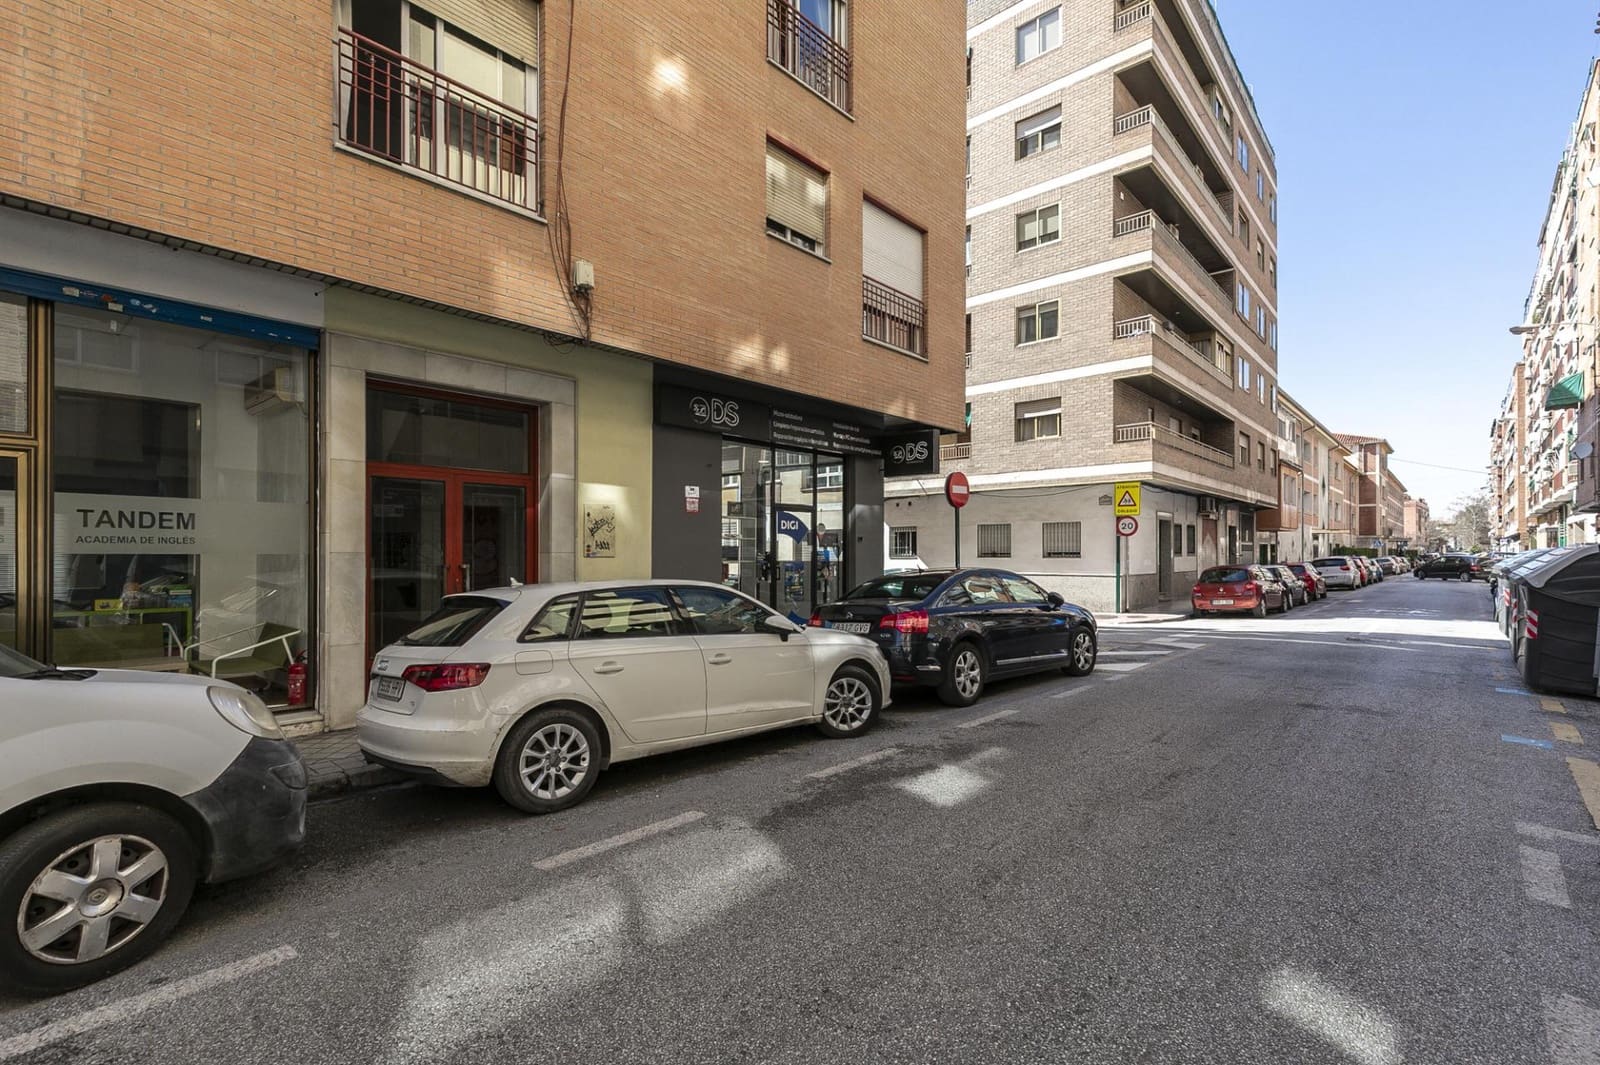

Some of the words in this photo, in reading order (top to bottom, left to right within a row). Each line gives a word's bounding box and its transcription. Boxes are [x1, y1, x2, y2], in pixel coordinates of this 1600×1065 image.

[711, 398, 740, 426] DS
[905, 440, 929, 461] DS
[76, 508, 196, 530] TANDEM
[780, 520, 799, 530] DIGI
[1121, 522, 1133, 530] 20
[75, 535, 137, 544] ACADEMIA
[140, 536, 155, 544] DE
